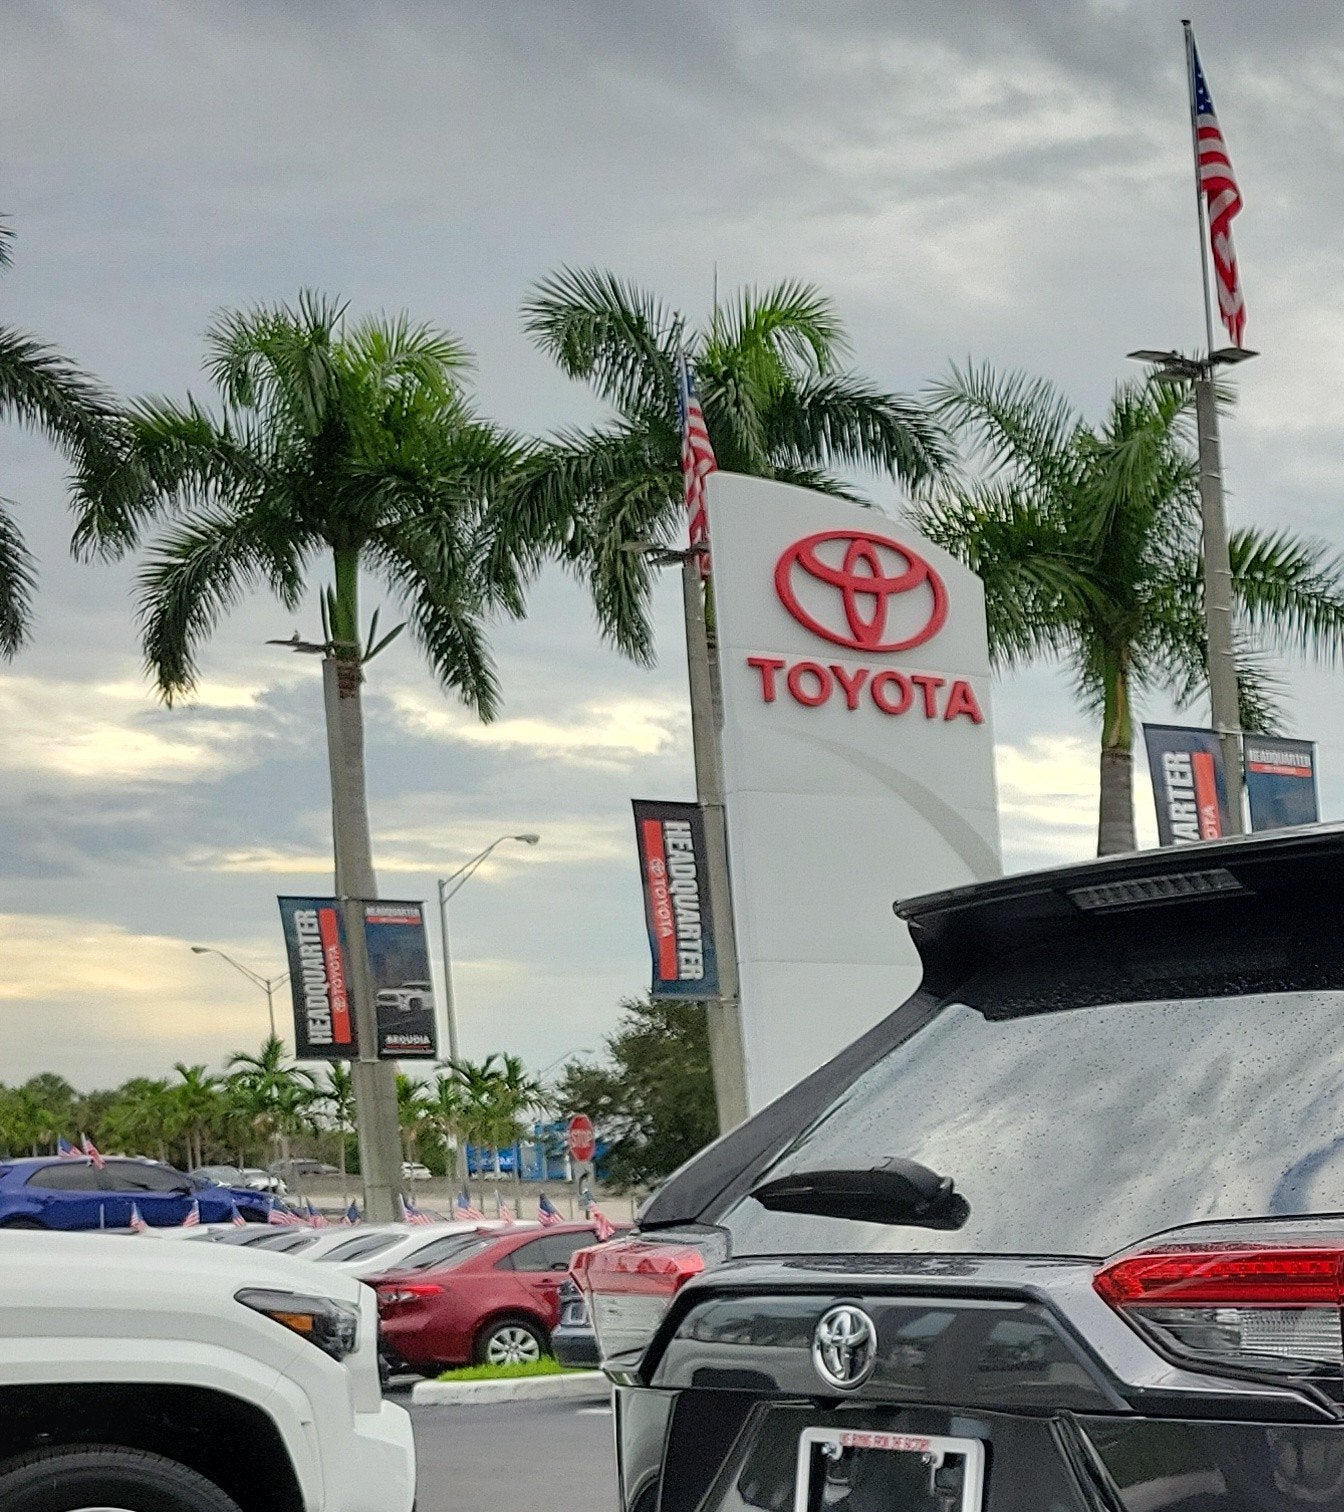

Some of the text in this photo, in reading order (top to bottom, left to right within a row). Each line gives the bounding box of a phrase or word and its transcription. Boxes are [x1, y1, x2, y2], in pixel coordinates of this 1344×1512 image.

[747, 657, 985, 724] TOYOTA
[653, 877, 674, 938] TOYOTA
[663, 820, 704, 981] HEADQUARTER
[295, 909, 334, 1045] HEADQUARTER
[328, 945, 346, 996] TOYOTA
[571, 1129, 592, 1148] STOP
